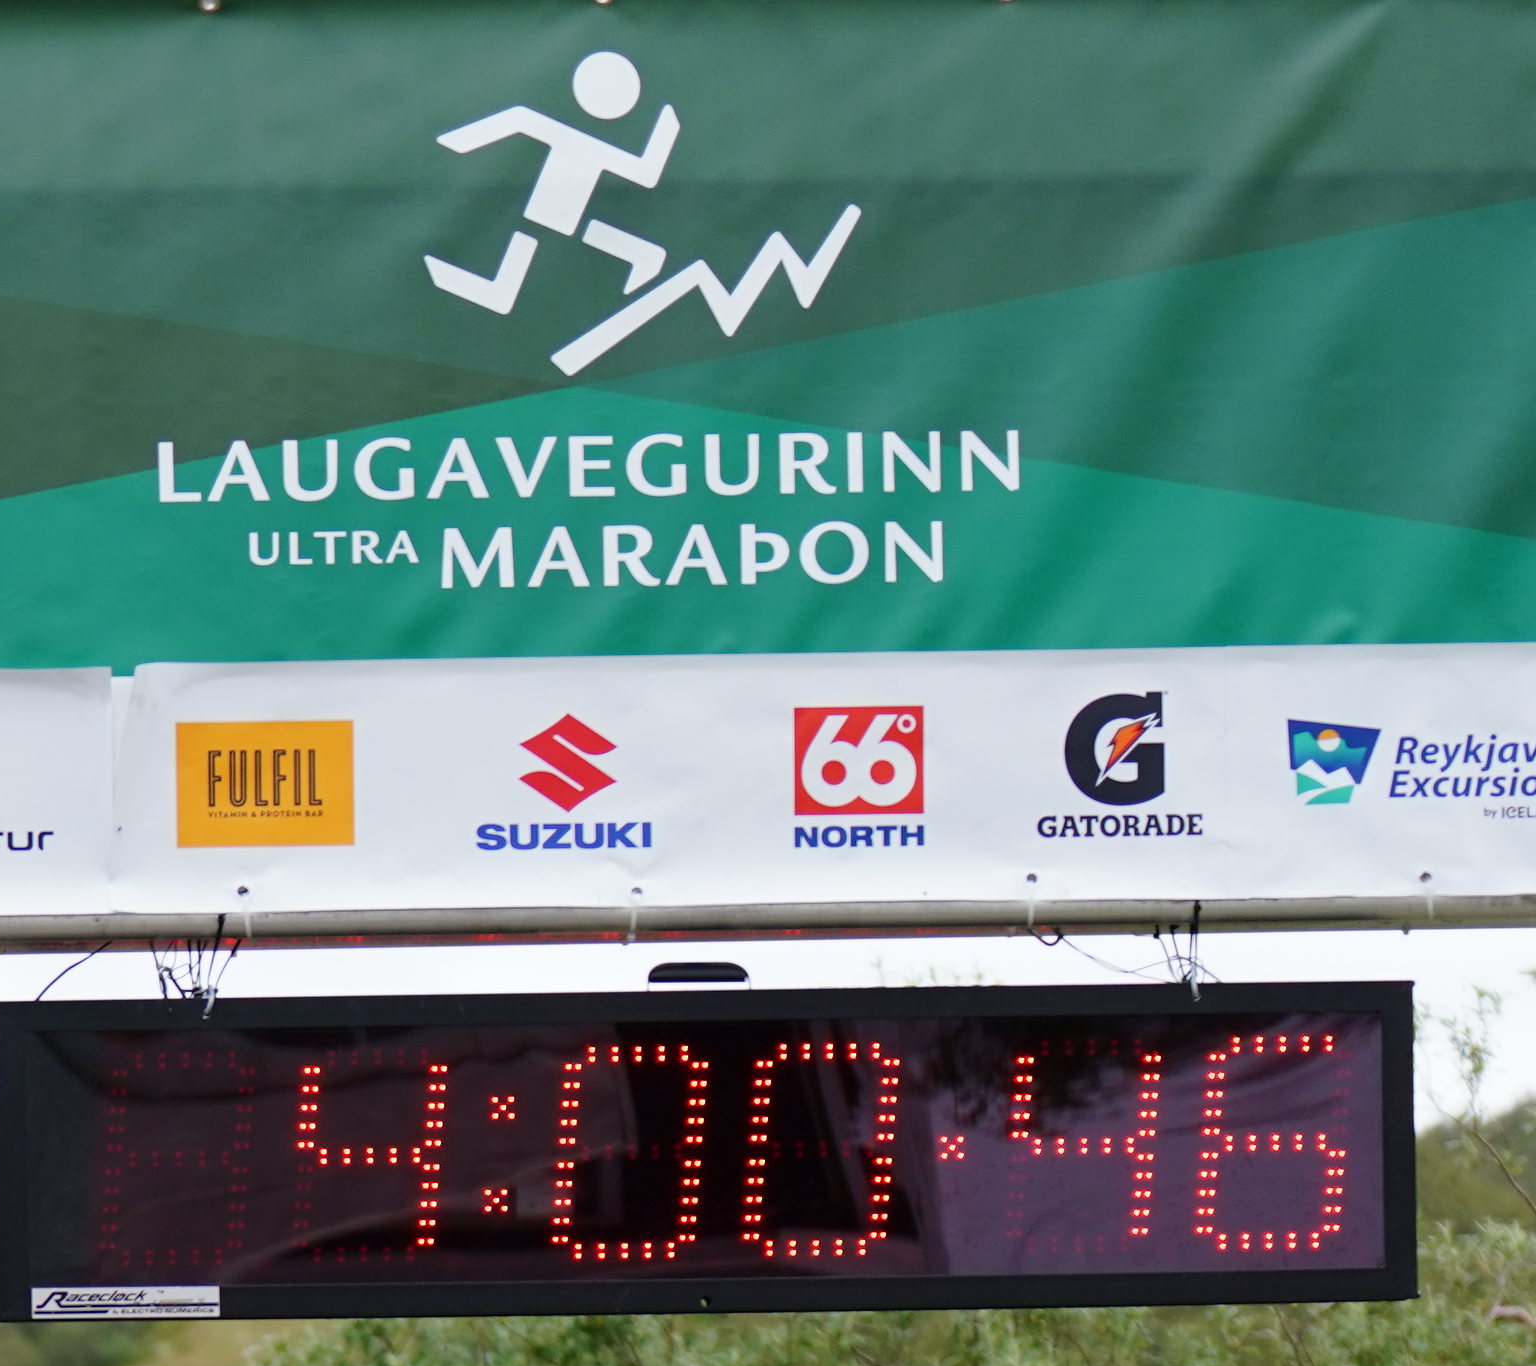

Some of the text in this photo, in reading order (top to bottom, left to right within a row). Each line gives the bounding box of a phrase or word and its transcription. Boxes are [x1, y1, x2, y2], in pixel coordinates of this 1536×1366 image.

[156, 429, 1021, 503] LAUGAVEGURINN
[247, 519, 945, 590] ULTRA MARAÞON
[207, 748, 323, 808] FULFIL
[207, 809, 248, 818] VITAMIN
[260, 808, 302, 818] PROTEIN
[304, 808, 324, 817] BAR
[1483, 806, 1498, 819] by
[475, 821, 653, 851] SUZUKI
[793, 824, 925, 849] NORTH
[1036, 813, 1204, 839] GATORADE
[35, 1290, 148, 1309] Raceclock
